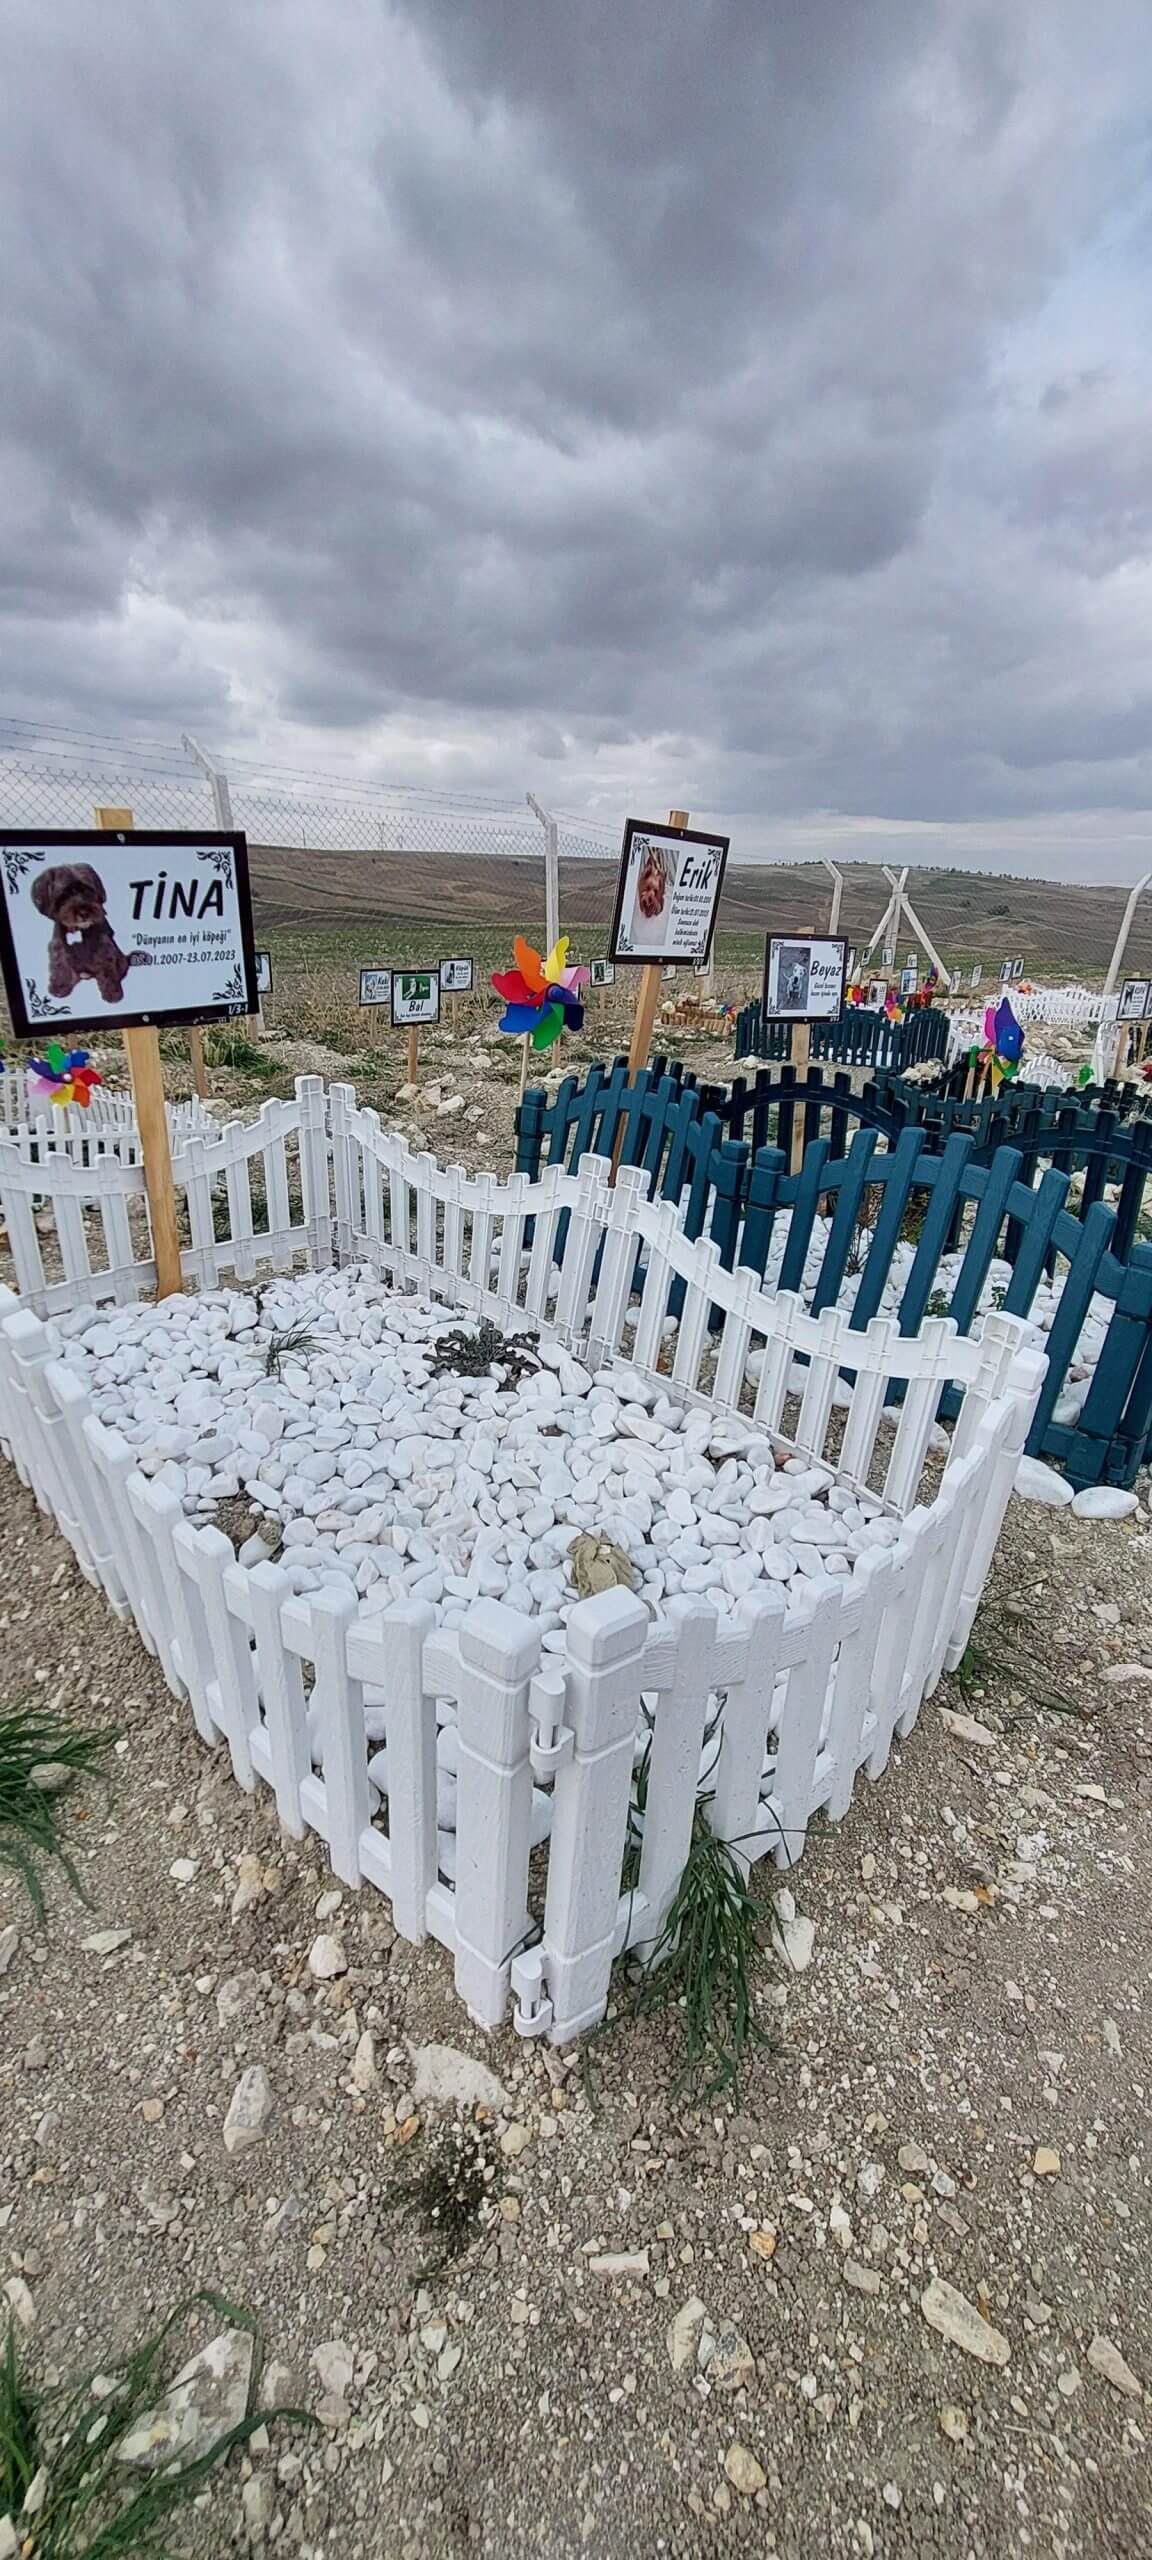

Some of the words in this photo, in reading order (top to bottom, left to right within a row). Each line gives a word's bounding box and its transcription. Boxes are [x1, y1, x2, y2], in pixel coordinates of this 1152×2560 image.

[679, 857, 713, 890] Erik
[129, 871, 224, 920] TİNA
[177, 935, 187, 944] en
[190, 931, 200, 946] iyi
[810, 960, 842, 981] Beyaz
[408, 1000, 425, 1012] Bal
